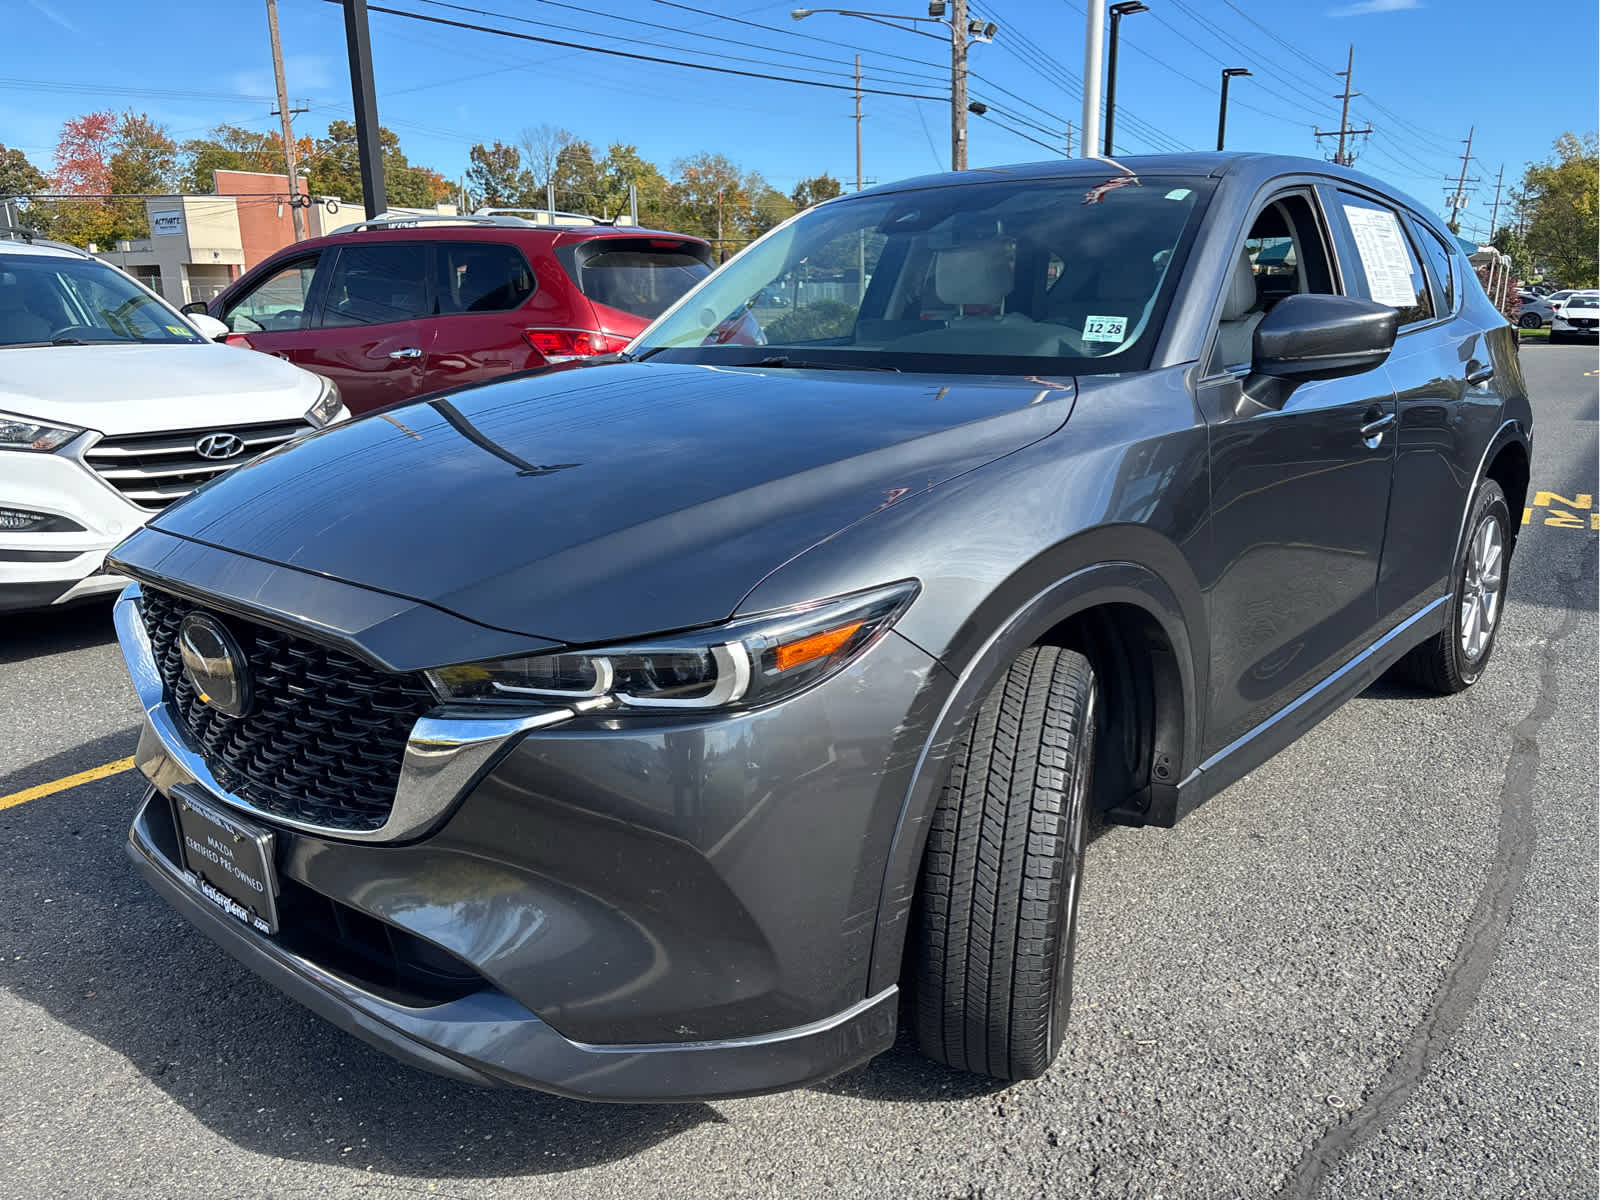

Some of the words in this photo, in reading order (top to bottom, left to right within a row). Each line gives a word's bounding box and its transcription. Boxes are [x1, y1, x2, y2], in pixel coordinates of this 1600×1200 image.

[1088, 323, 1103, 334] 12
[1107, 323, 1122, 335] 28
[207, 834, 234, 860] MAZDA
[185, 835, 219, 864] CERTIFIED
[220, 856, 264, 892] PRE-OWNED
